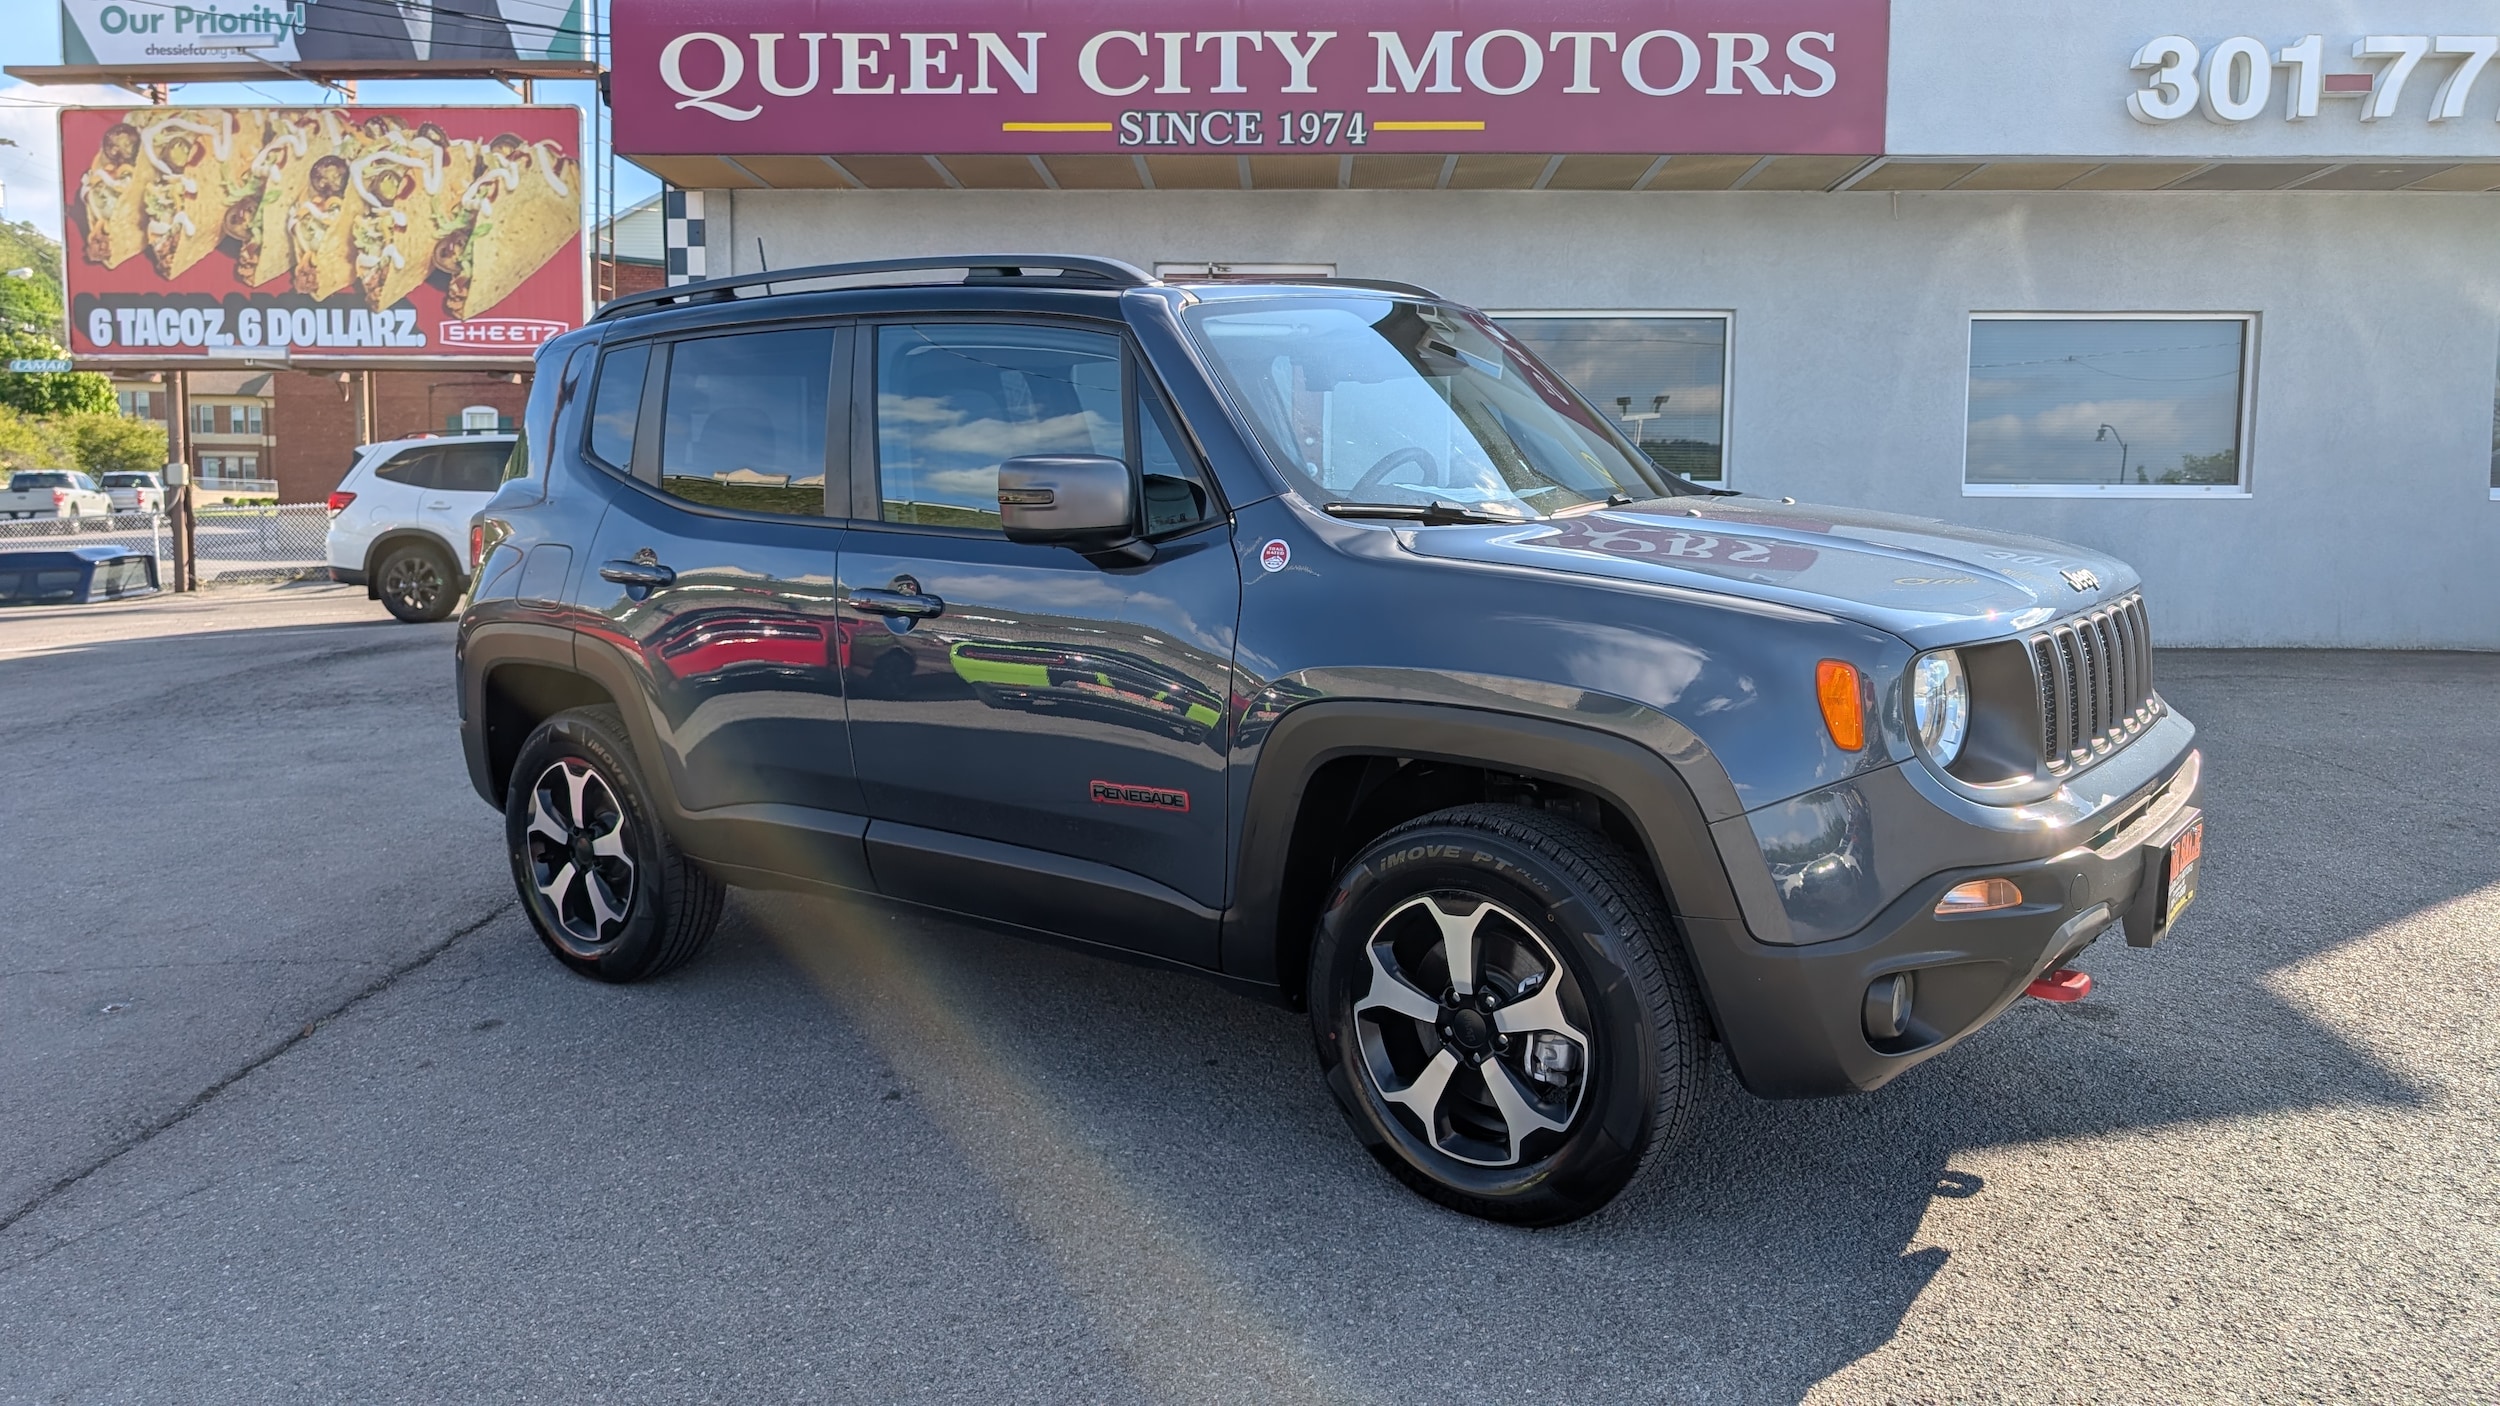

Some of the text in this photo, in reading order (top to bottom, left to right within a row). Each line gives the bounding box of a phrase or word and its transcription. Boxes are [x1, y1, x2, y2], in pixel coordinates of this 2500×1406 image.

[100, 2, 306, 42] Our Priority!
[659, 29, 1837, 121] QUEEN CITY MOTORS
[2126, 34, 2500, 125] 301-77
[1118, 109, 1368, 146] SINCE 1974
[89, 307, 427, 347] 6 TACOZ. 6 DOLLARZ.
[449, 325, 560, 341] SHEETZ
[15, 360, 67, 371] LAMAR
[2060, 568, 2100, 592] Jeep
[1093, 785, 1185, 807] RENEGADE
[1379, 844, 1464, 873] iMOVE
[1471, 851, 1514, 871] PT
